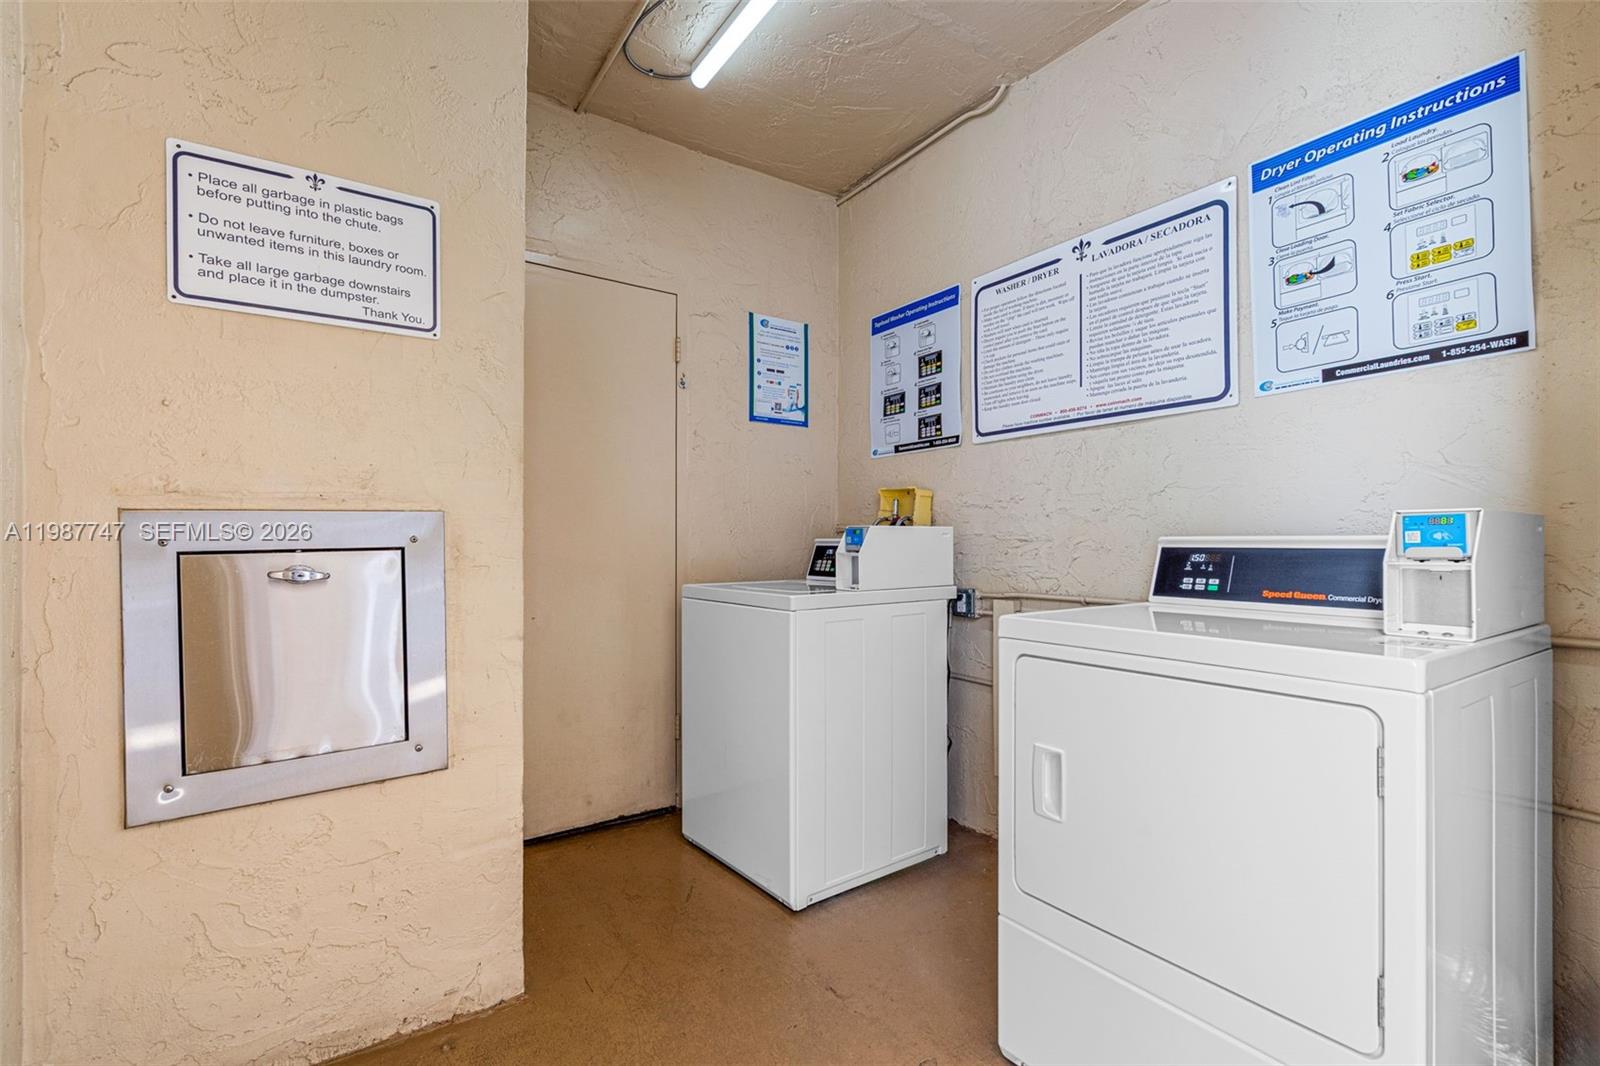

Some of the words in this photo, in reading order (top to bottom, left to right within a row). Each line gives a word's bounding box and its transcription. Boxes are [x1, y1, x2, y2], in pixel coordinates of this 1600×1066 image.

[1260, 157, 1301, 180] Dryer
[1304, 123, 1385, 162] Operating
[1390, 75, 1505, 129] Instructions
[196, 185, 241, 203] before
[246, 197, 290, 216] putting
[295, 205, 318, 219] into
[322, 212, 341, 224] the
[345, 217, 380, 232] chute.
[198, 171, 237, 189] Place
[242, 183, 256, 193] all
[261, 188, 315, 206] garbage
[319, 198, 329, 209] in
[334, 203, 372, 218] plastic
[375, 210, 403, 225] bags
[197, 227, 264, 247] unwanted
[269, 239, 304, 254] items
[308, 246, 319, 257] in
[323, 249, 344, 261] this
[348, 254, 391, 272] laundry
[395, 264, 425, 276] room.
[198, 212, 218, 225] Do
[223, 219, 244, 230] not
[249, 222, 284, 238] leave
[289, 230, 344, 250] furniture,
[348, 241, 383, 257] boxes
[387, 251, 398, 259] or
[1091, 238, 1142, 261] LAVADORA
[1150, 214, 1210, 240] SECADORA
[197, 268, 223, 279] and
[229, 272, 265, 286] place
[269, 278, 277, 288] it
[281, 279, 292, 290] in
[296, 283, 316, 294] the
[320, 286, 378, 304] dumpster.
[198, 252, 231, 267] Take
[236, 260, 251, 270] all
[256, 262, 288, 278] large
[293, 271, 344, 287] garbage
[348, 279, 410, 297] downstairs
[995, 279, 1025, 294] WASHER
[1031, 267, 1059, 282] DRYER
[362, 306, 398, 320] Thank
[401, 312, 424, 324] You.
[1441, 337, 1516, 357] 1-855-254-WASH
[1262, 590, 1293, 599] Speed
[1327, 594, 1367, 603] Commercial
